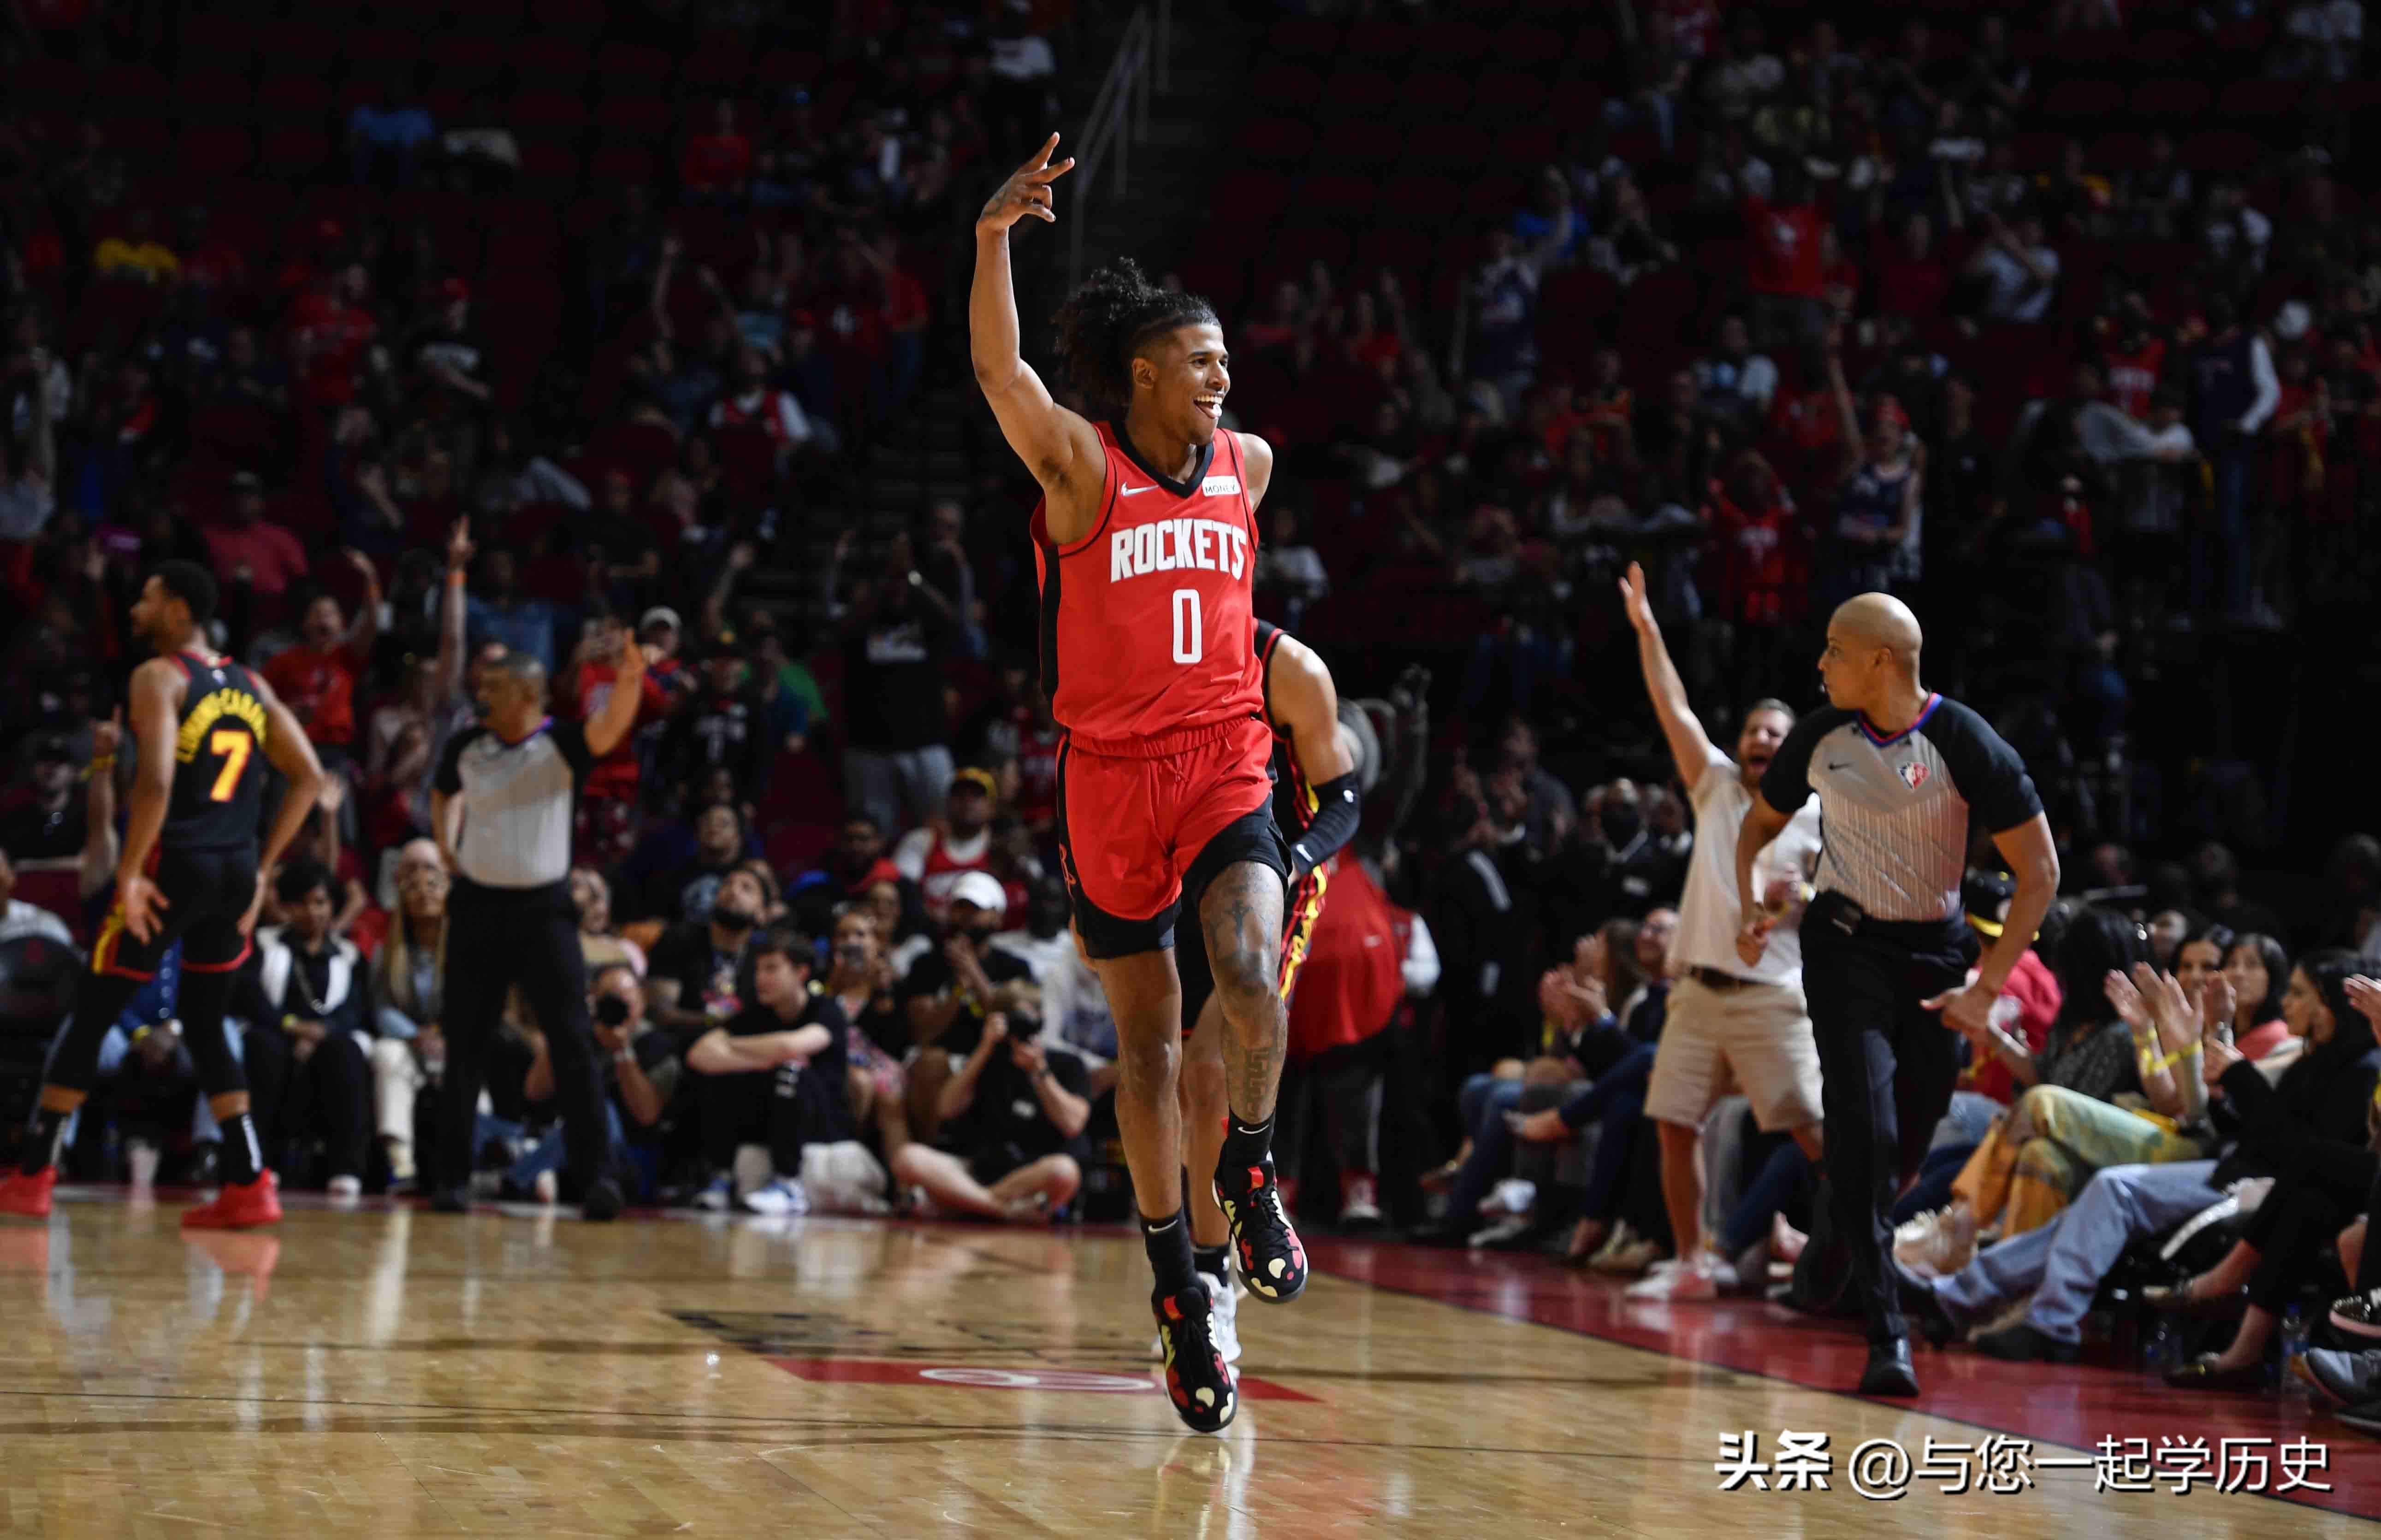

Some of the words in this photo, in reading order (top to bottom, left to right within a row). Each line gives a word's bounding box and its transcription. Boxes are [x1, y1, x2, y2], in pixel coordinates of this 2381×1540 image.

[1111, 518, 1246, 583] ROCKETS
[1173, 589, 1202, 664] 0
[209, 729, 252, 802] 7
